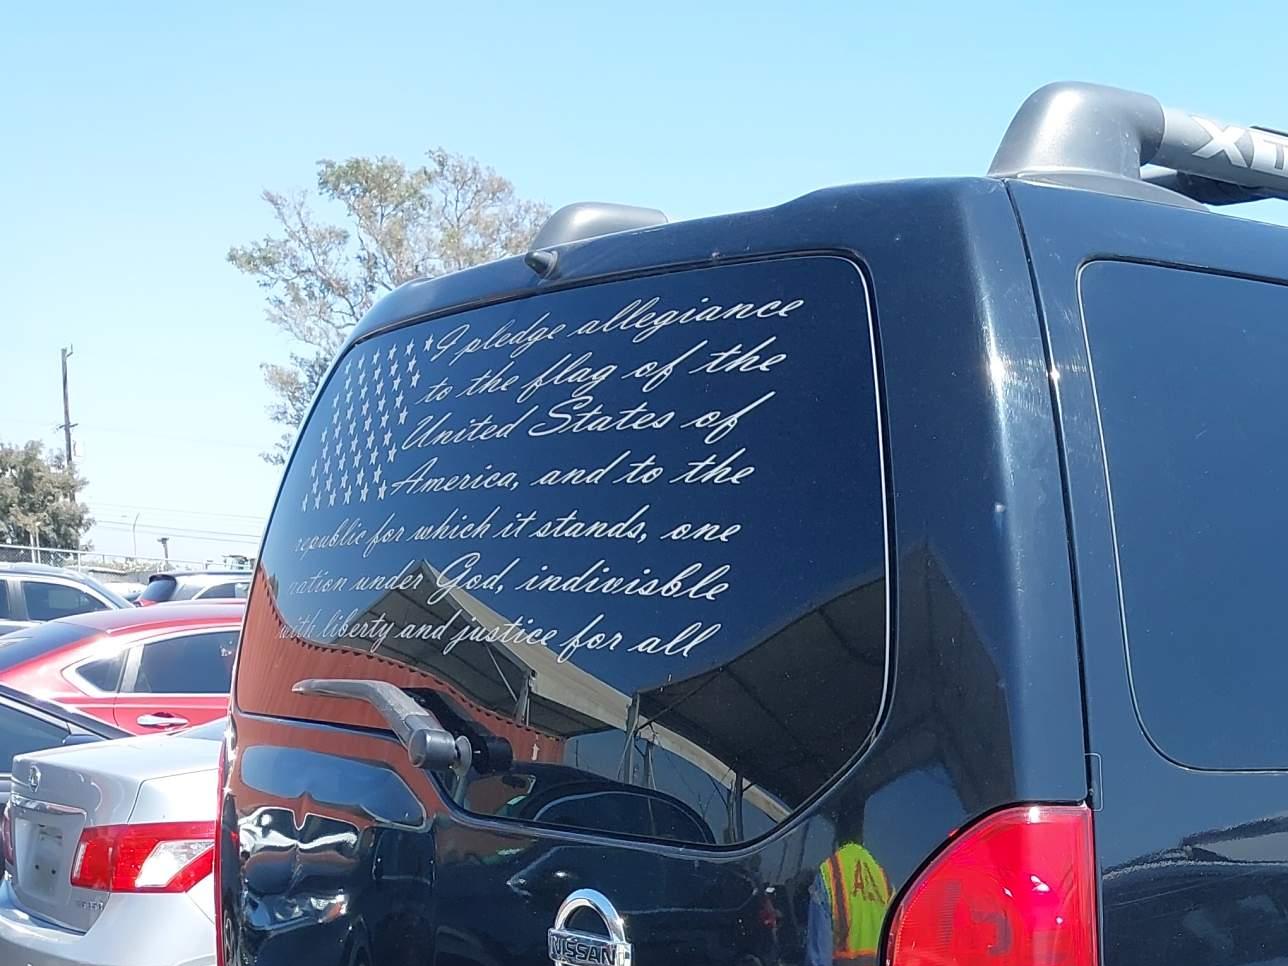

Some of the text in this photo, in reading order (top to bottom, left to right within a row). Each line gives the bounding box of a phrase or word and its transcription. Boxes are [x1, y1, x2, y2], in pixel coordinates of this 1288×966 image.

[432, 296, 804, 365] I pledge allegiance
[415, 336, 788, 404] to the flag of the
[401, 391, 776, 451] United States of
[390, 448, 755, 496] America, and to the
[362, 512, 406, 559] for
[405, 506, 500, 543] which
[496, 509, 538, 540] it
[529, 505, 650, 545] stands,
[659, 523, 742, 543] one
[349, 559, 424, 591] under
[433, 552, 510, 605] God,
[318, 607, 396, 654] liberty
[395, 610, 453, 642] and
[445, 616, 557, 654] justice
[556, 614, 624, 664] for
[627, 622, 722, 658] all
